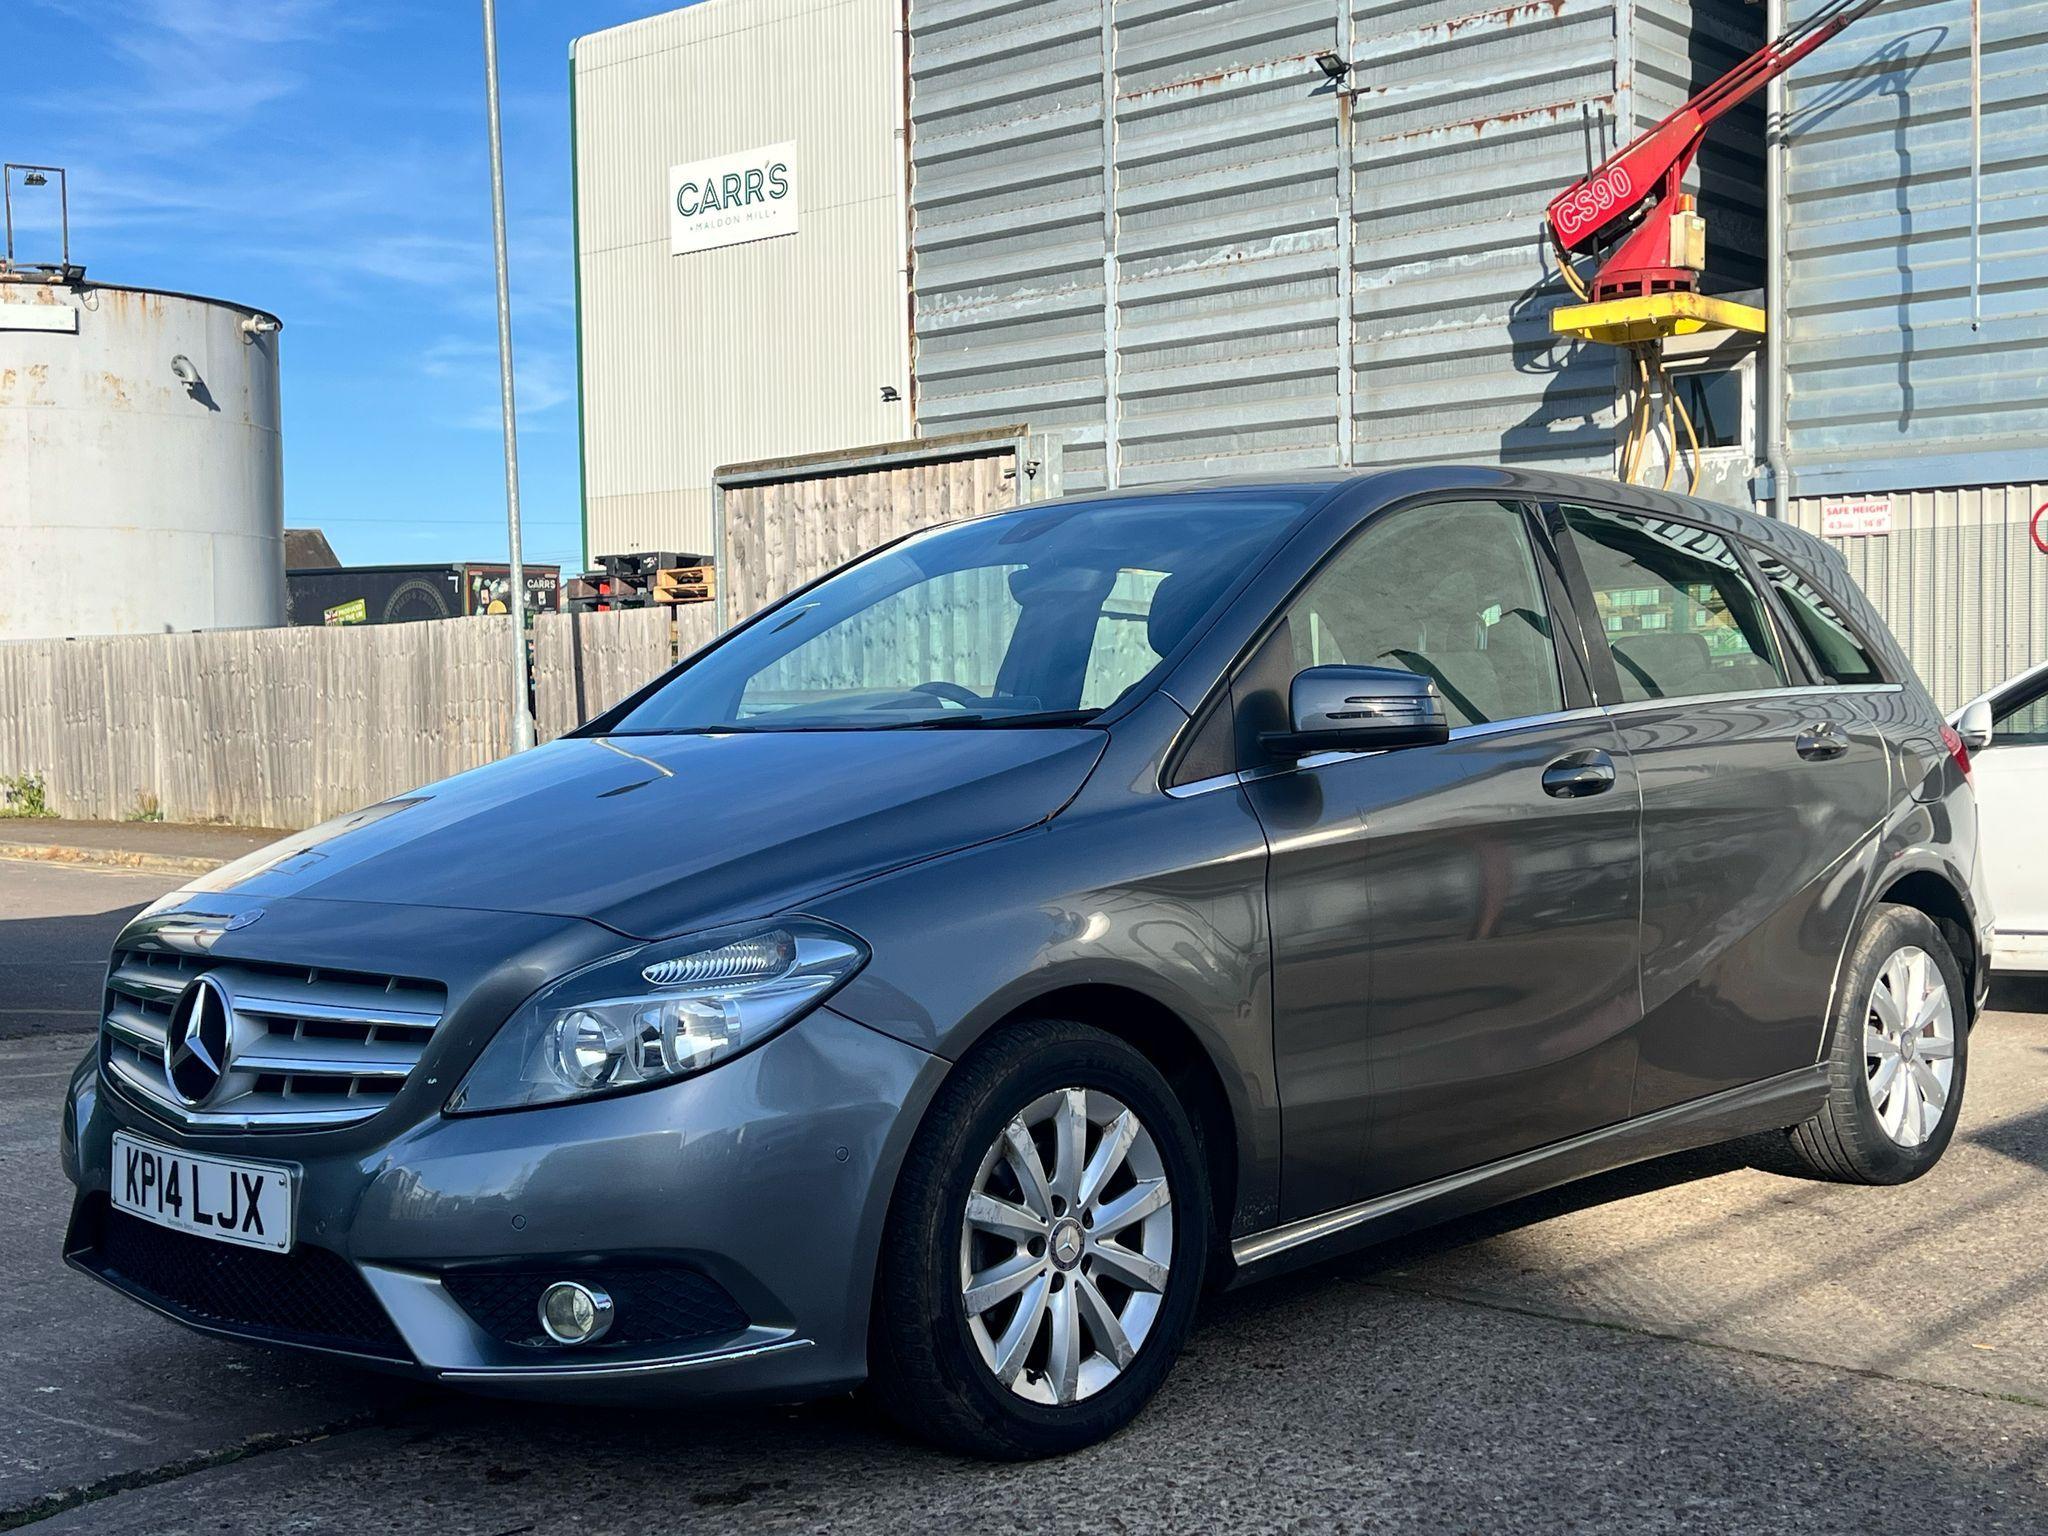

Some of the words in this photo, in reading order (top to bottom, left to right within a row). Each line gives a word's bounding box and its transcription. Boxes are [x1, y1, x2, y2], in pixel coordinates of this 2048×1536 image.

[695, 215, 740, 231] MALDON
[746, 210, 770, 222] MILL
[1557, 166, 1632, 234] CS90
[1827, 507, 1849, 516] SAFE
[1853, 505, 1888, 514] HEIGHT
[126, 1146, 182, 1218] KP14
[191, 1164, 264, 1236] LJX
